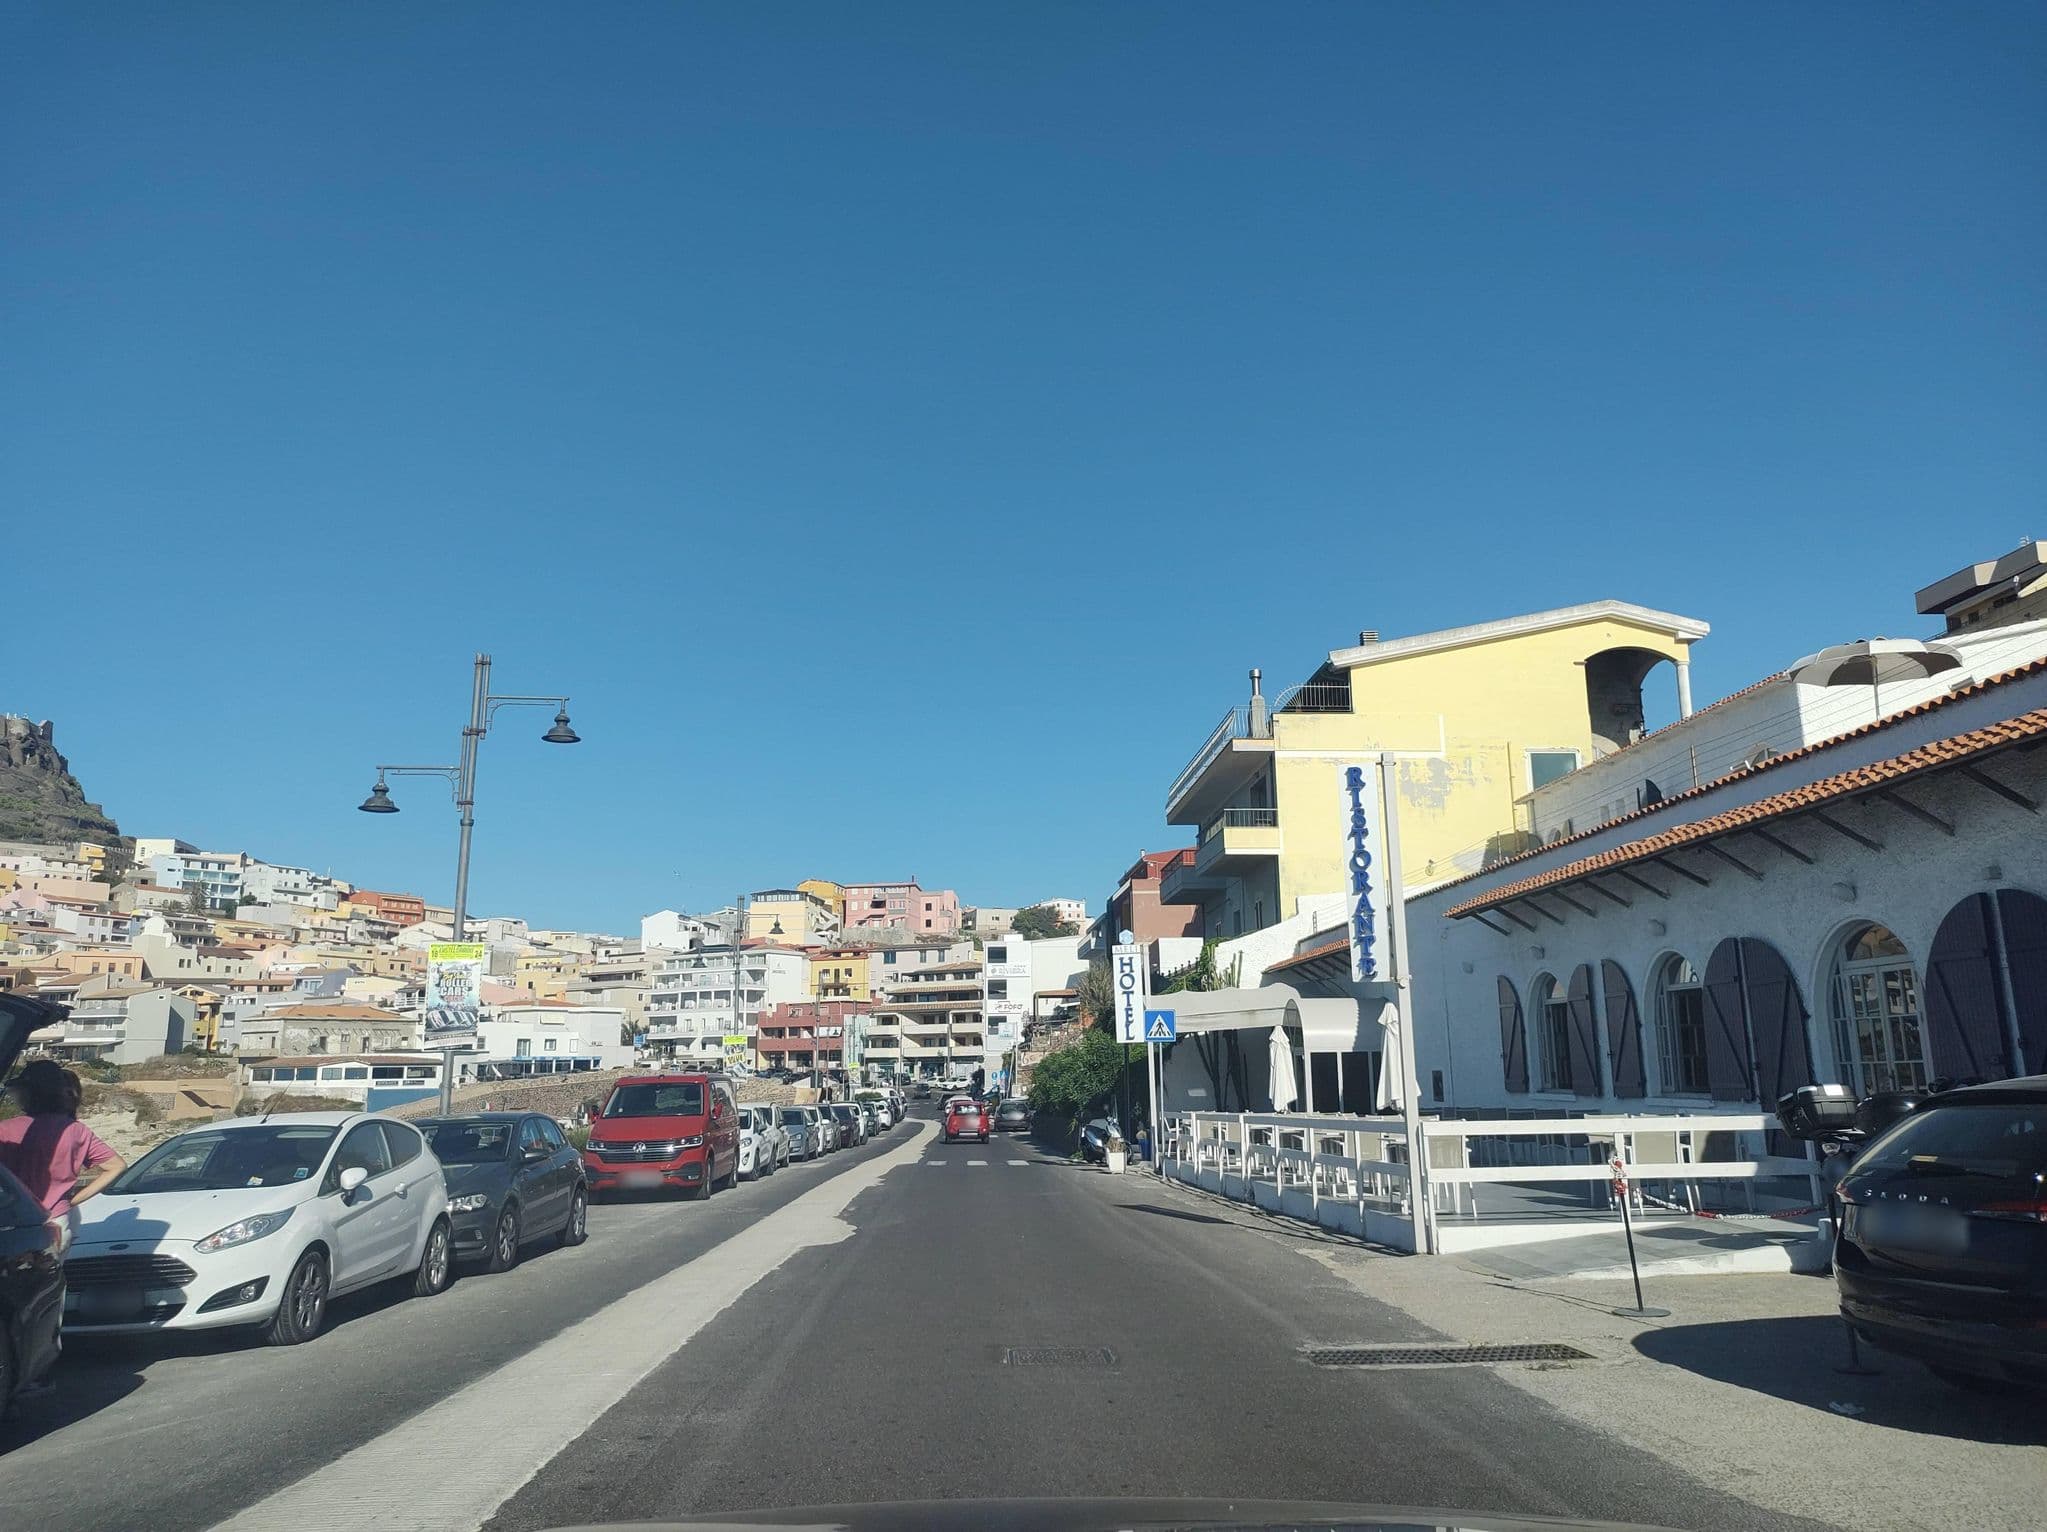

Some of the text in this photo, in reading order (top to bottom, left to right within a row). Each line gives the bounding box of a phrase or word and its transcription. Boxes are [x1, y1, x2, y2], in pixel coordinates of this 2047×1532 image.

[1344, 767, 1378, 982] RISTORANTE
[440, 978, 473, 987] ROLLER
[440, 987, 469, 996] CARS
[1118, 956, 1136, 1041] HOTEL
